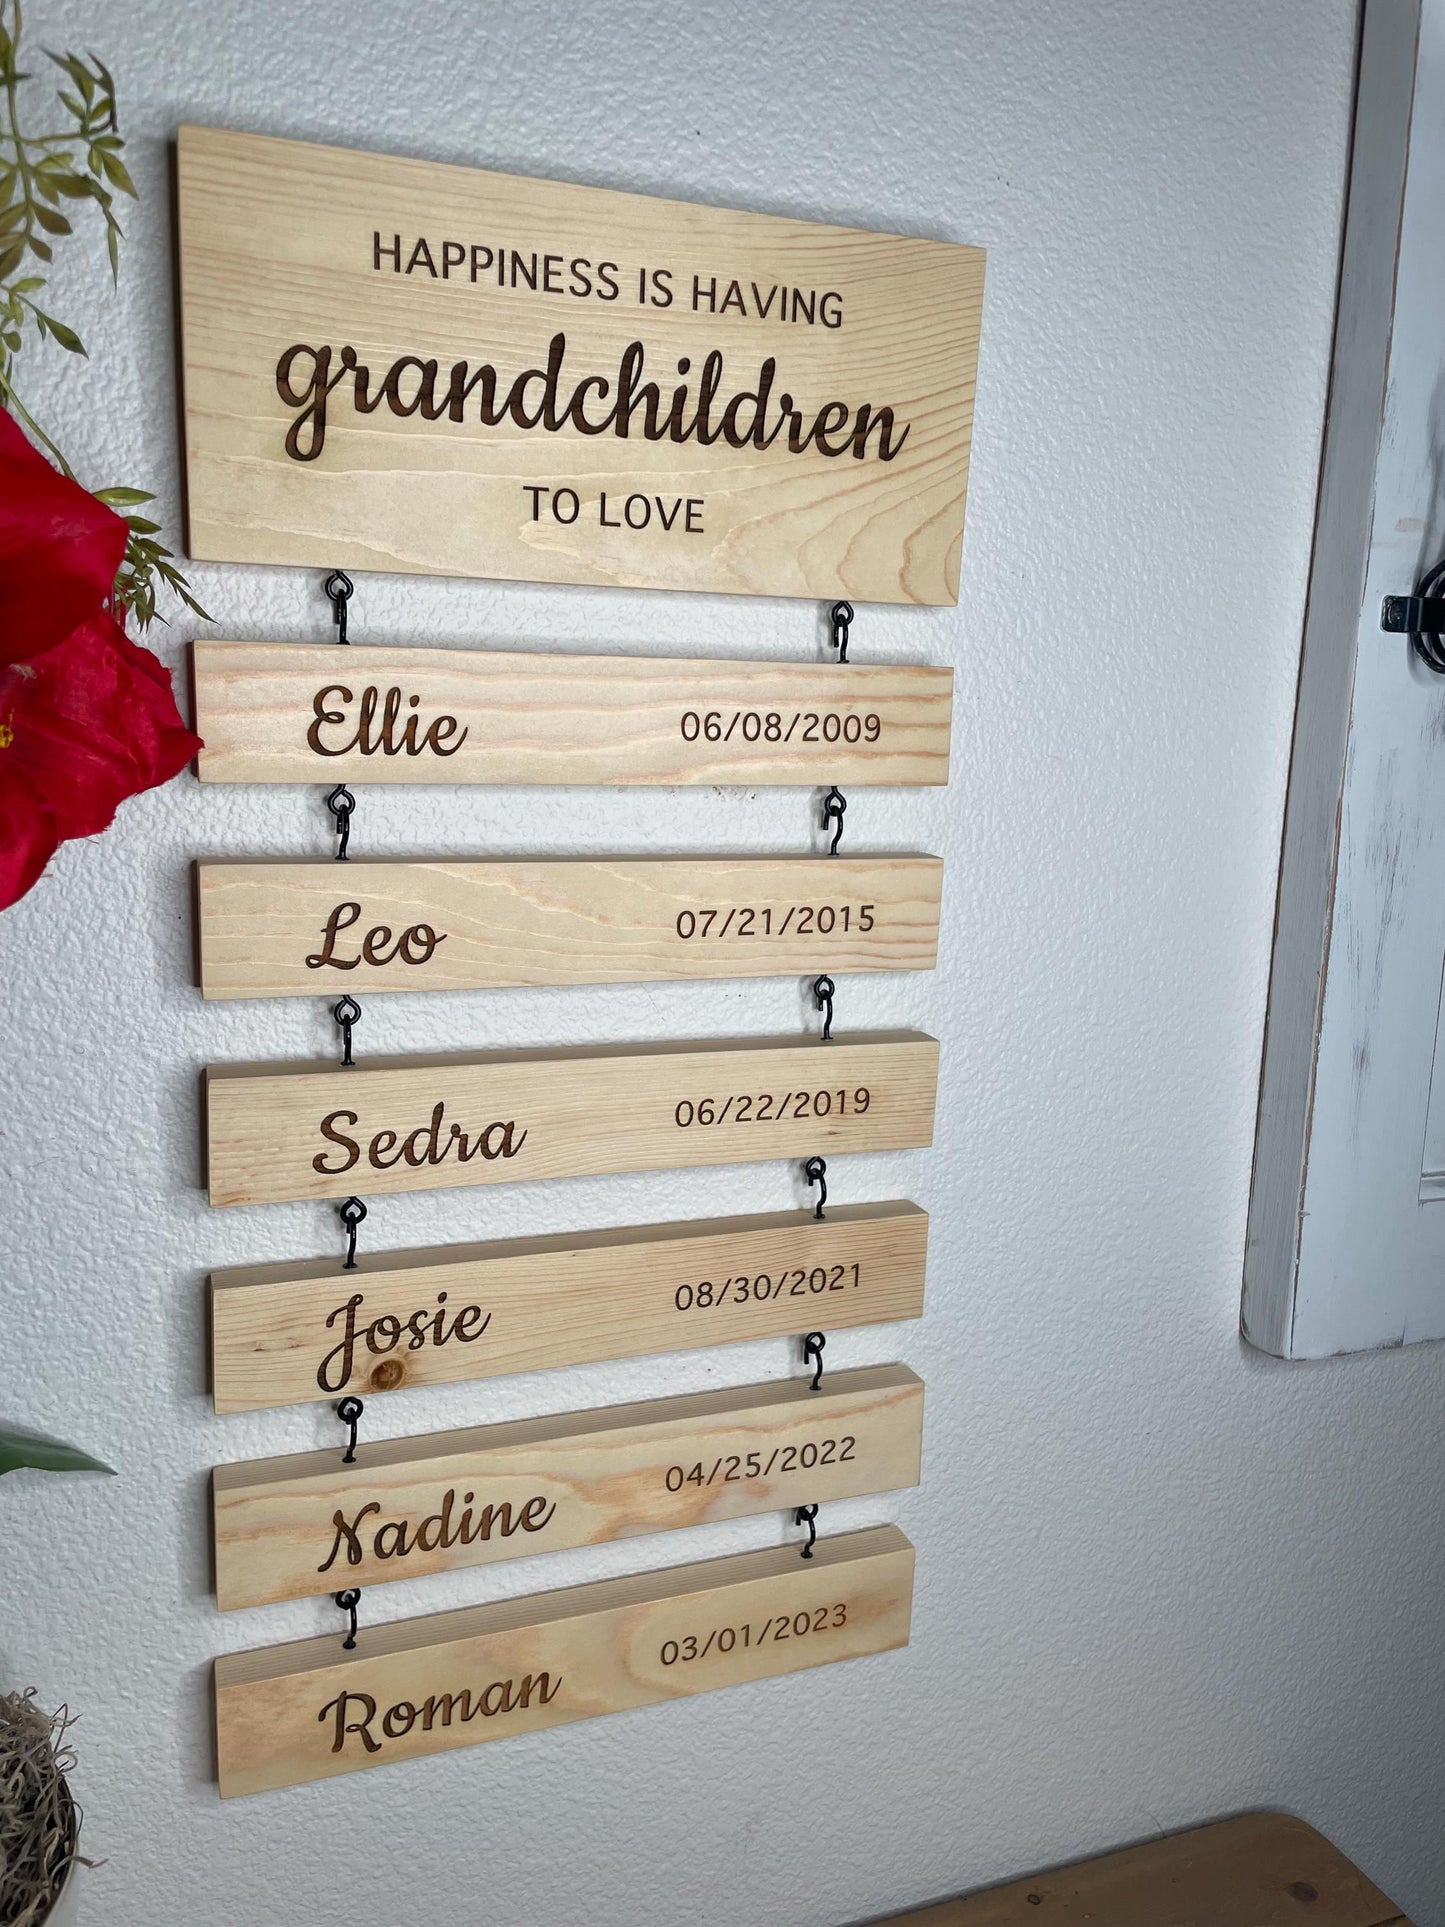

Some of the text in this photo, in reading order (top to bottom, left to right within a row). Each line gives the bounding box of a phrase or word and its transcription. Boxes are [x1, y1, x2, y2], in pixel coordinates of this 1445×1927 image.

[374, 231, 843, 329] HAPPINESS IS HAVING
[275, 331, 911, 462] grandchildren
[522, 485, 705, 534] TO LOVE
[306, 684, 881, 757] Ellie 06/08/2009
[304, 901, 875, 971] Leo 07/21/2015
[312, 1087, 871, 1175] Sedra 06/22/2019
[316, 1263, 860, 1393] Josie 08/30/2021
[317, 1436, 856, 1573] Nadine 04/25/2022
[317, 1603, 847, 1754] Roman 03/01/2023
